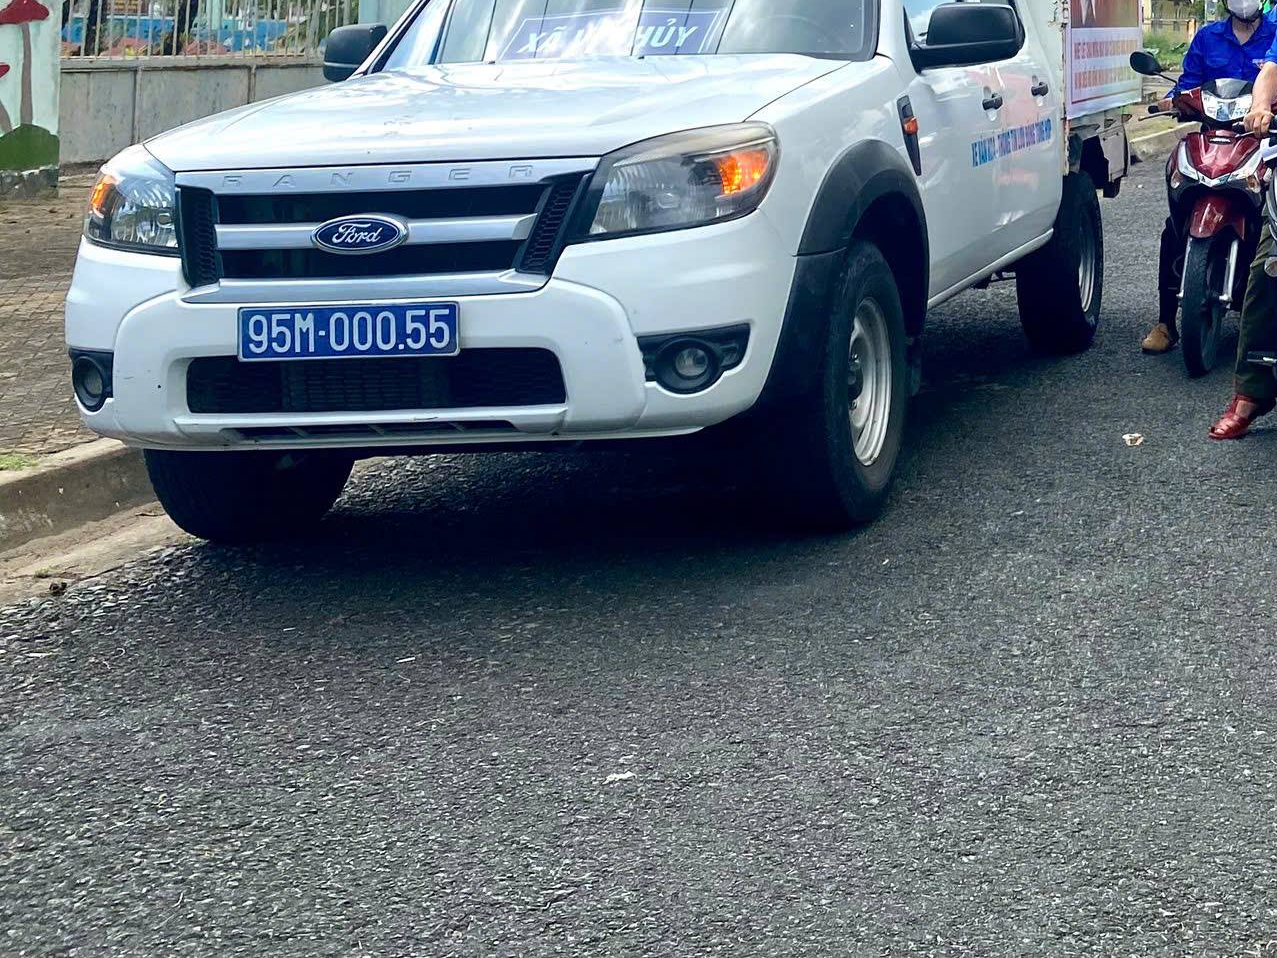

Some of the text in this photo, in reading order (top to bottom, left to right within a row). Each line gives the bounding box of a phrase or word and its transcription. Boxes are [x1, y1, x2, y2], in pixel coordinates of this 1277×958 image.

[617, 18, 698, 50] HỦY
[222, 164, 533, 188] RANGER
[331, 223, 382, 244] Ford
[248, 308, 451, 354] 95M-000.55
